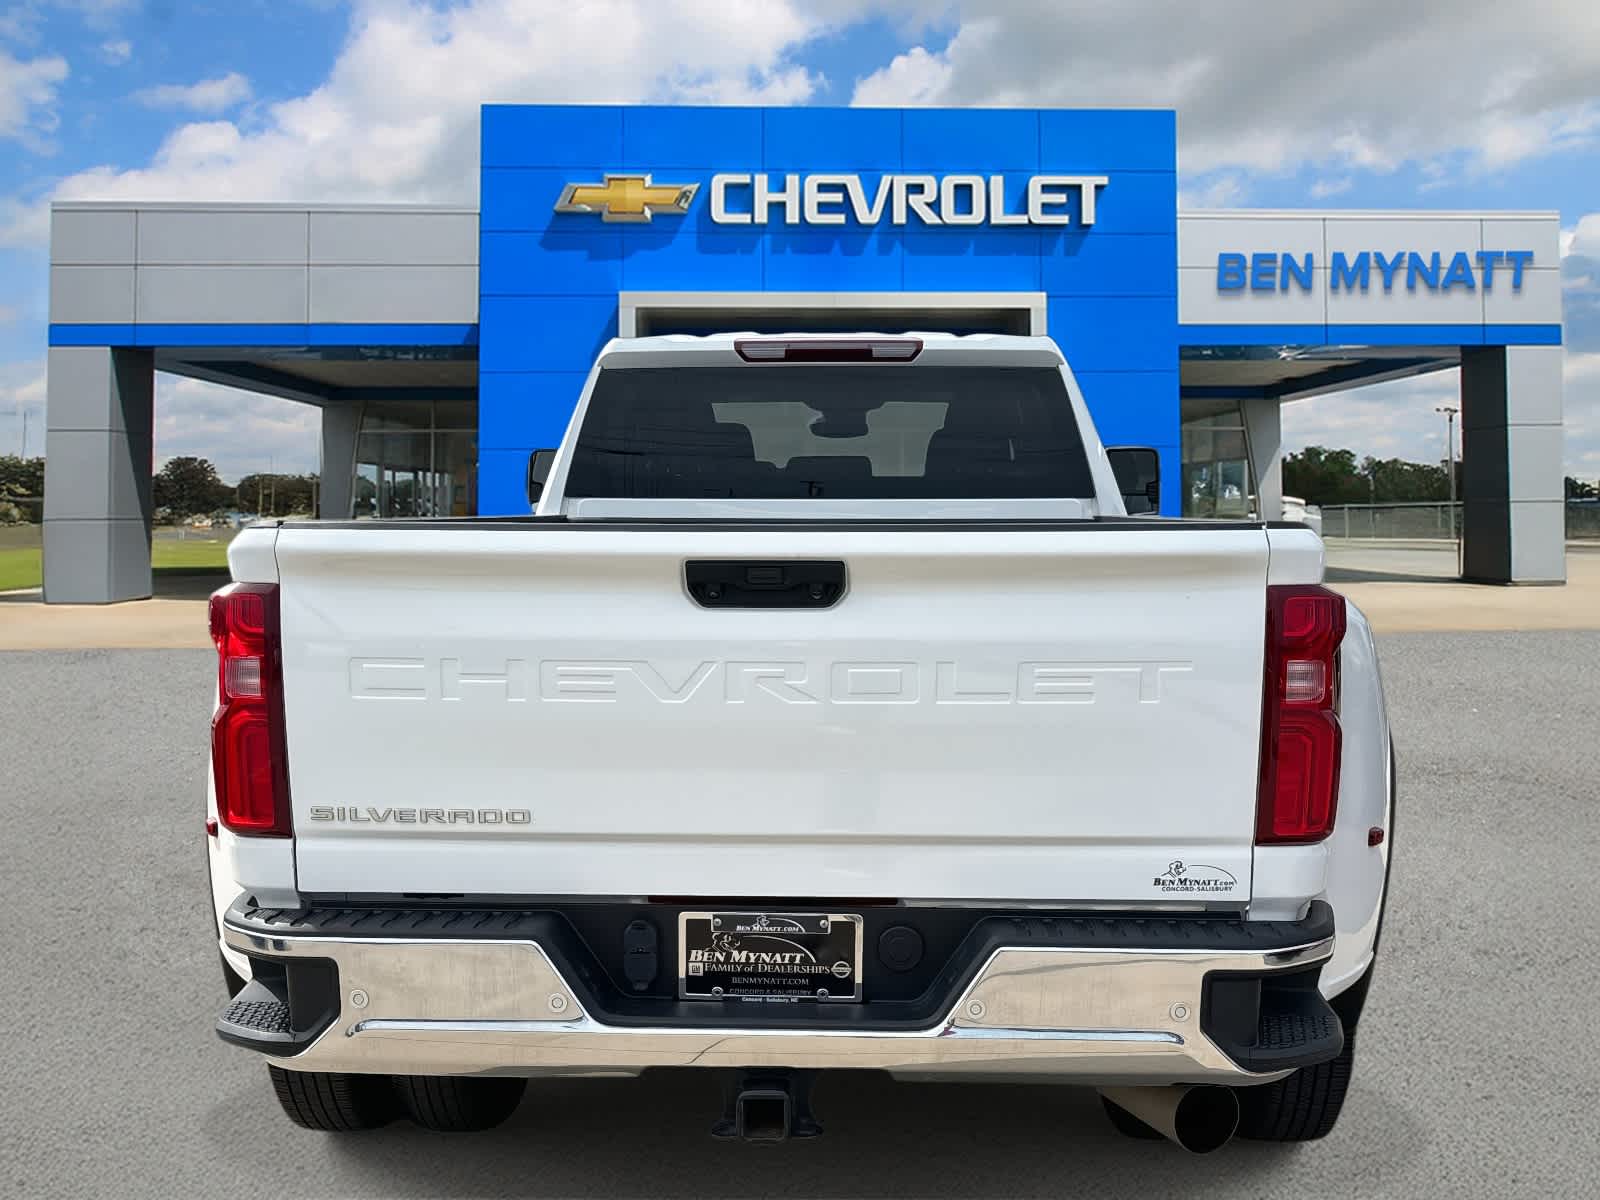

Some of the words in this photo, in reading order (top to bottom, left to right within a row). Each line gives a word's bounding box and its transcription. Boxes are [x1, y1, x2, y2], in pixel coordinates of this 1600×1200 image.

[710, 173, 1109, 225] CHEVROLET
[1217, 252, 1313, 290] BEN
[1330, 250, 1534, 290] MYNATT
[349, 657, 1193, 705] CHEVROLET
[310, 806, 531, 824] SILVERADO
[688, 950, 726, 962] BEN
[730, 950, 804, 963] MYNATT
[704, 963, 742, 972] FAMILY
[758, 963, 830, 974] DEALERSHIPS
[732, 977, 809, 985] BENMYNATT.COM
